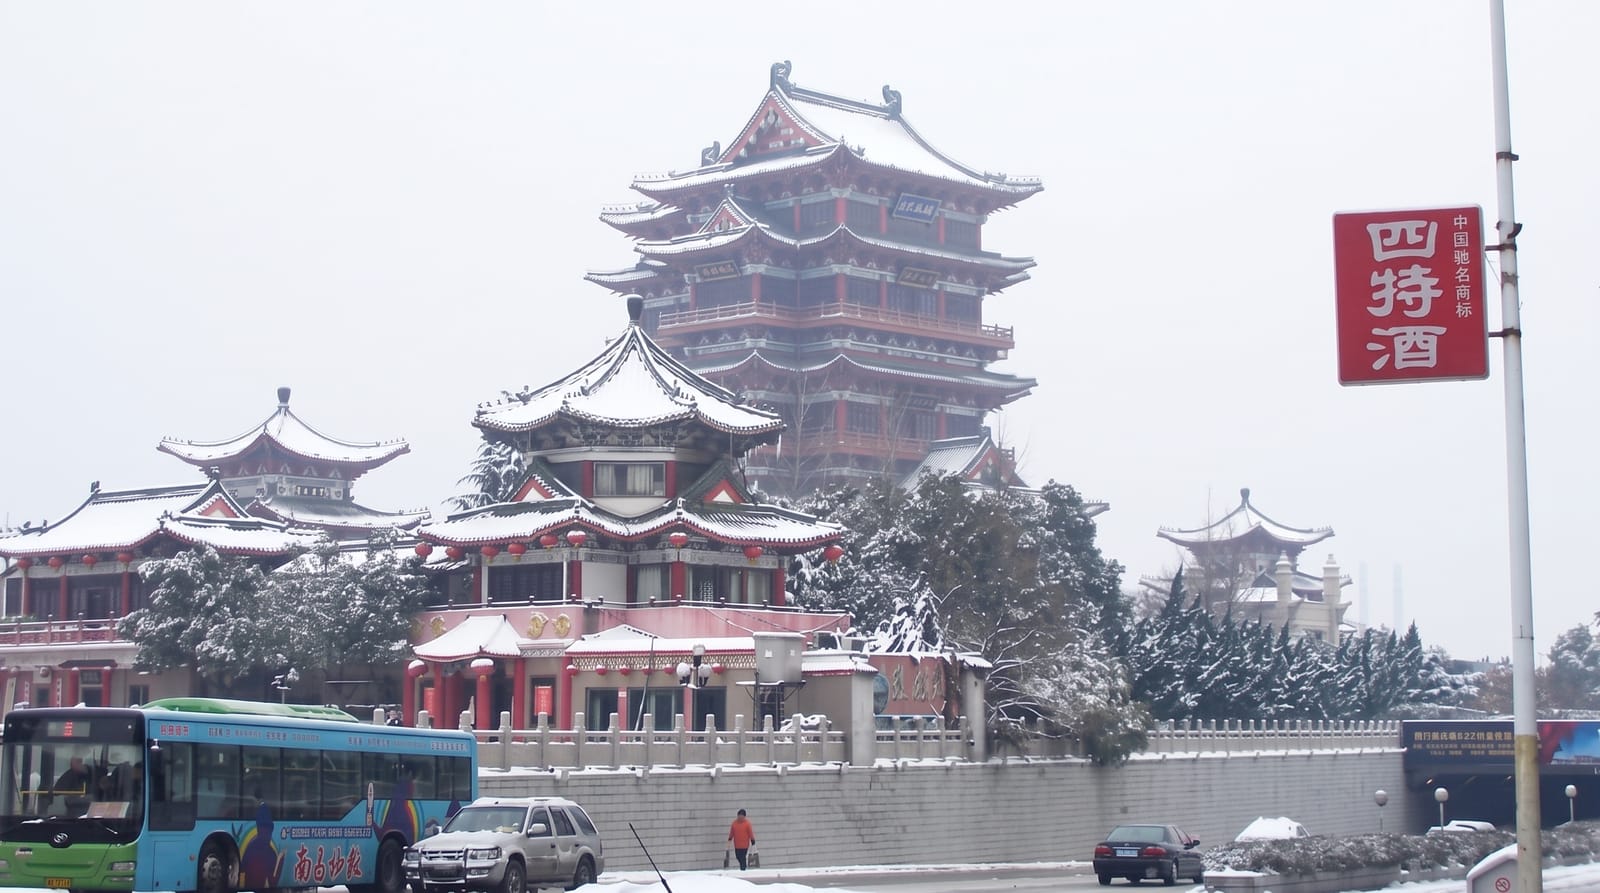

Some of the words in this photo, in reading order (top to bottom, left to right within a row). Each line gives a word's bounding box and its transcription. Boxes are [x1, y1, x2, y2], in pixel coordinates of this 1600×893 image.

[1366, 220, 1447, 371] 四特酒
[1453, 214, 1473, 318] 中国驰名商标
